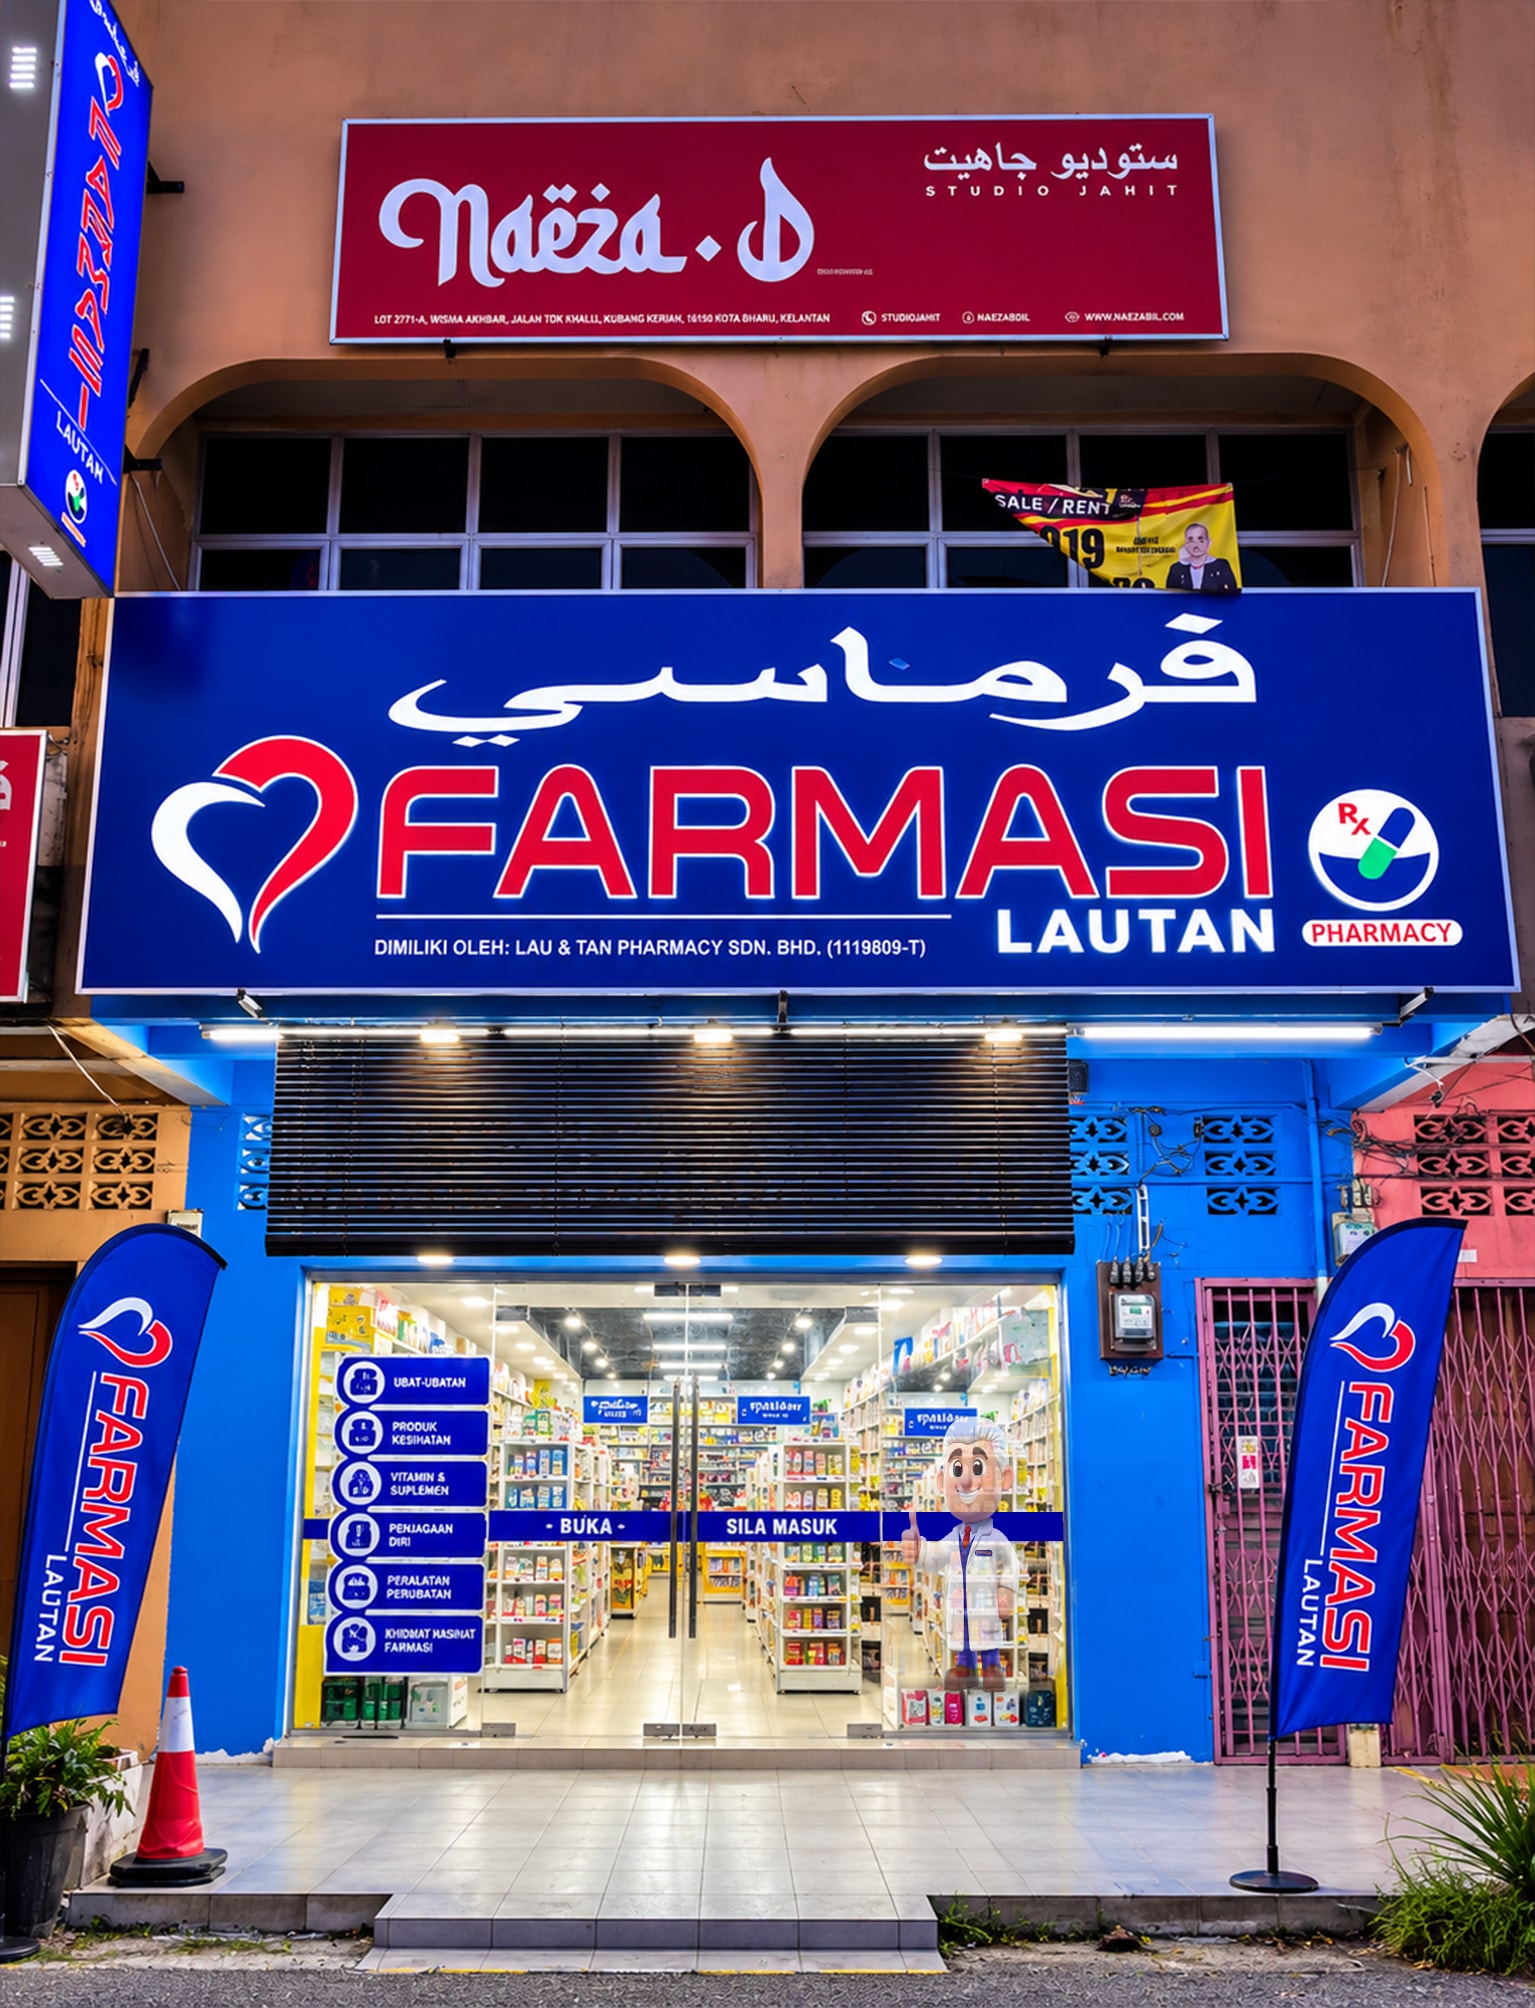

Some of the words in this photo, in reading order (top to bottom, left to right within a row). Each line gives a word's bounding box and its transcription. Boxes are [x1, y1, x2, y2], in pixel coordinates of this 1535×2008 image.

[925, 185, 1049, 197] STUDIO
[1079, 184, 1178, 197] JAHIT
[374, 314, 393, 324] LOT
[430, 314, 464, 324] WISMA
[511, 314, 542, 324] JALAN
[544, 314, 564, 324] TOK
[603, 314, 645, 324] KUBANG
[714, 313, 741, 323] KOTA
[742, 313, 779, 324] BHARU,
[780, 313, 831, 323] KELANTAN
[881, 313, 940, 322] STUDIOJAHIT
[994, 494, 1043, 511] SALE
[1061, 499, 1111, 515] RENT
[376, 764, 1274, 900] FARMASI
[997, 908, 1276, 954] LAUTAN
[1310, 922, 1454, 945] PHARMACY
[374, 939, 448, 956] DIMILIKI
[453, 939, 510, 956] OLEH:
[515, 939, 553, 956] LAU
[557, 939, 571, 956] &
[576, 939, 612, 956] TAN
[617, 939, 723, 956] PHARMACY
[728, 939, 771, 956] SDN.
[777, 939, 821, 956] BHD.
[827, 938, 926, 959] (1119809-T)
[393, 1377, 467, 1388] UBAT-UBATAN
[392, 1422, 438, 1432] PRODUK
[391, 1435, 451, 1446] KESIHATAN
[390, 1471, 435, 1483] VITAMIN
[390, 1485, 449, 1496] SUPLEMEN
[60, 1372, 148, 1667] FARMASI
[388, 1523, 454, 1534] PENJAGAAN
[560, 1518, 613, 1535] BUKA
[726, 1518, 767, 1535] SILA
[773, 1518, 837, 1535] MASUK
[1319, 1381, 1394, 1672] FARMASI
[388, 1537, 411, 1547] DIRI
[387, 1575, 451, 1586] PERALATAN
[386, 1589, 452, 1600] PERUBATAN
[34, 1554, 67, 1662] LAUTAN
[1297, 1559, 1323, 1666] LAUTAN
[384, 1641, 433, 1653] FARMASI
